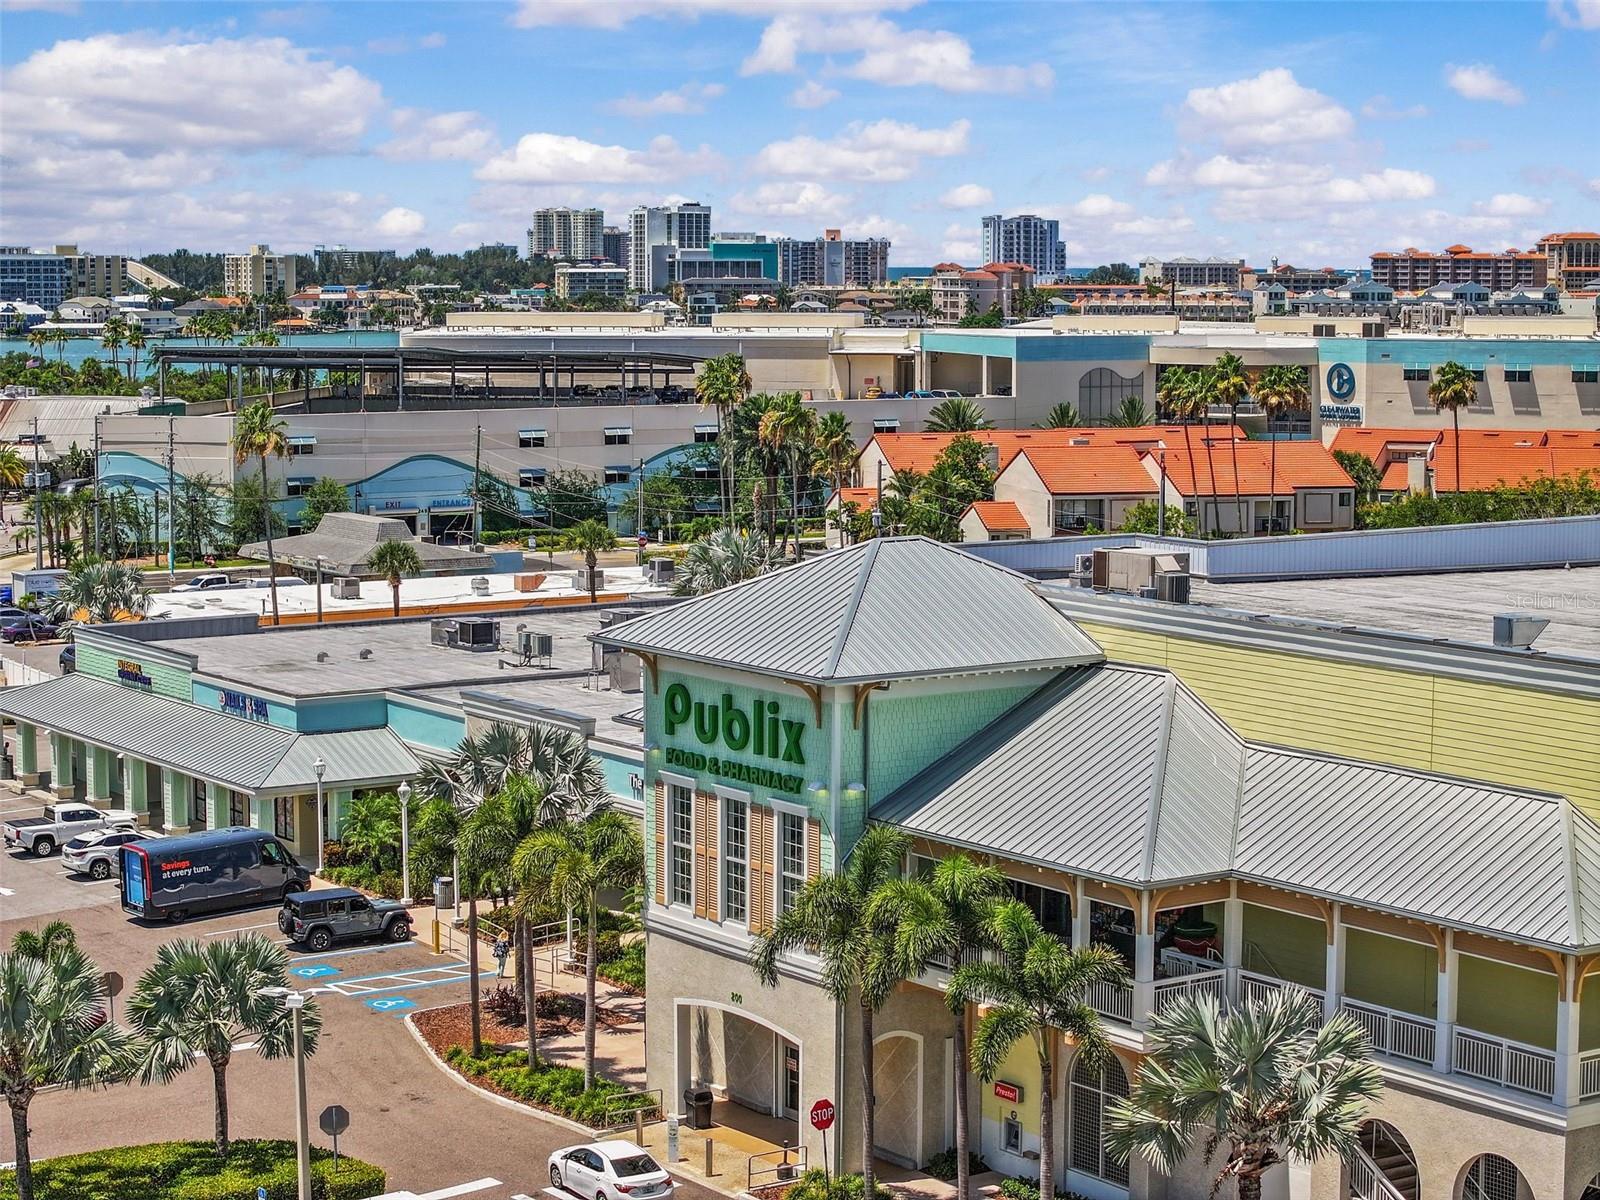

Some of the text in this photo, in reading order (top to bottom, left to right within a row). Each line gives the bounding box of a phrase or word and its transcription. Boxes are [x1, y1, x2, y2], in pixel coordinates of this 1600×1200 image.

[385, 501, 401, 509] EXIT
[432, 498, 471, 507] ENTRANCE
[253, 698, 269, 718] SPA
[664, 683, 806, 765] Publix
[665, 747, 804, 794] FOOD & PHARMACY
[627, 772, 645, 790] The
[161, 860, 191, 871] Savings
[162, 865, 212, 879] at every turn.
[995, 1086, 1016, 1100] Presto!
[811, 1107, 834, 1123] STOP
